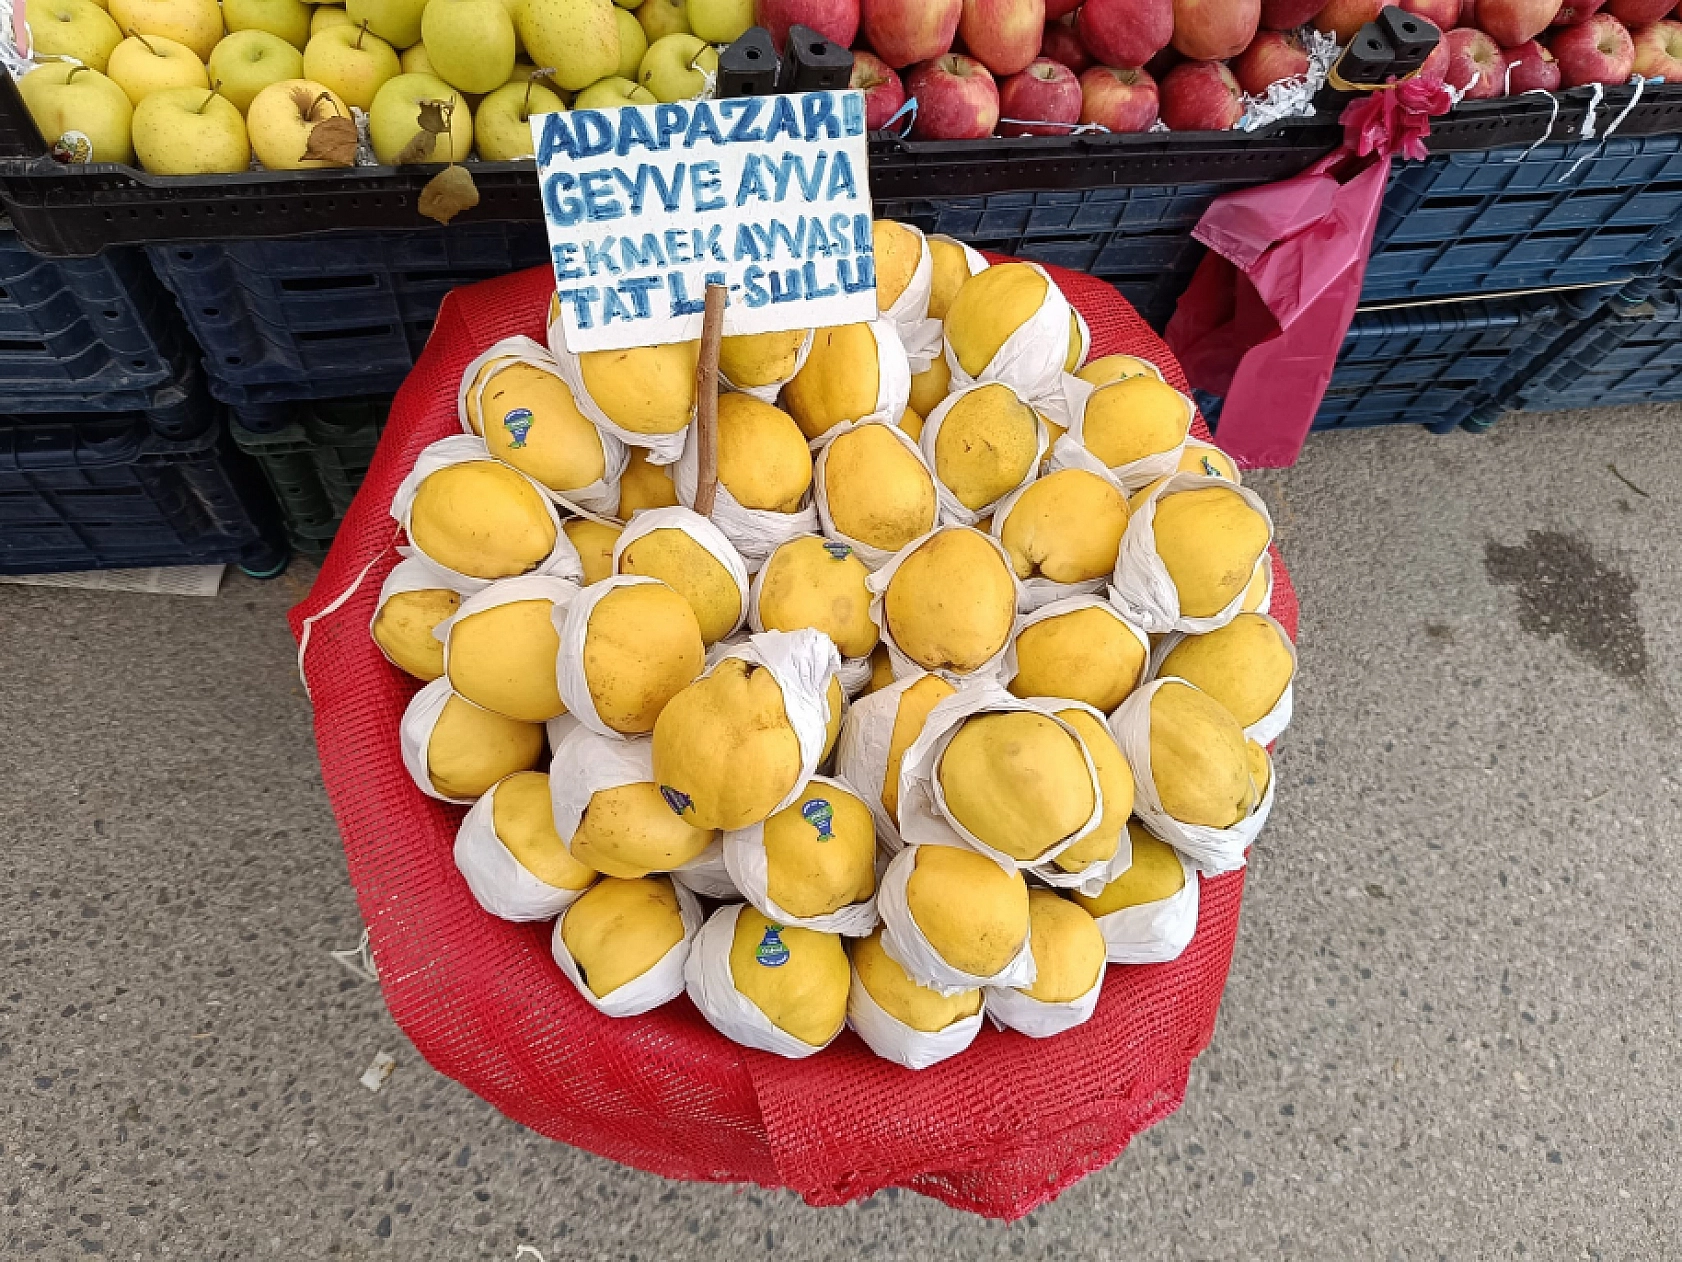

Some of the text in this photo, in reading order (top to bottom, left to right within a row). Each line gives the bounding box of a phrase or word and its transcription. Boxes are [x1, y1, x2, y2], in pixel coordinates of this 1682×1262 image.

[537, 91, 864, 166] ADAPAZARI
[544, 150, 858, 225] GEYVE AYVA
[551, 213, 874, 281] EKMEK AYVASI
